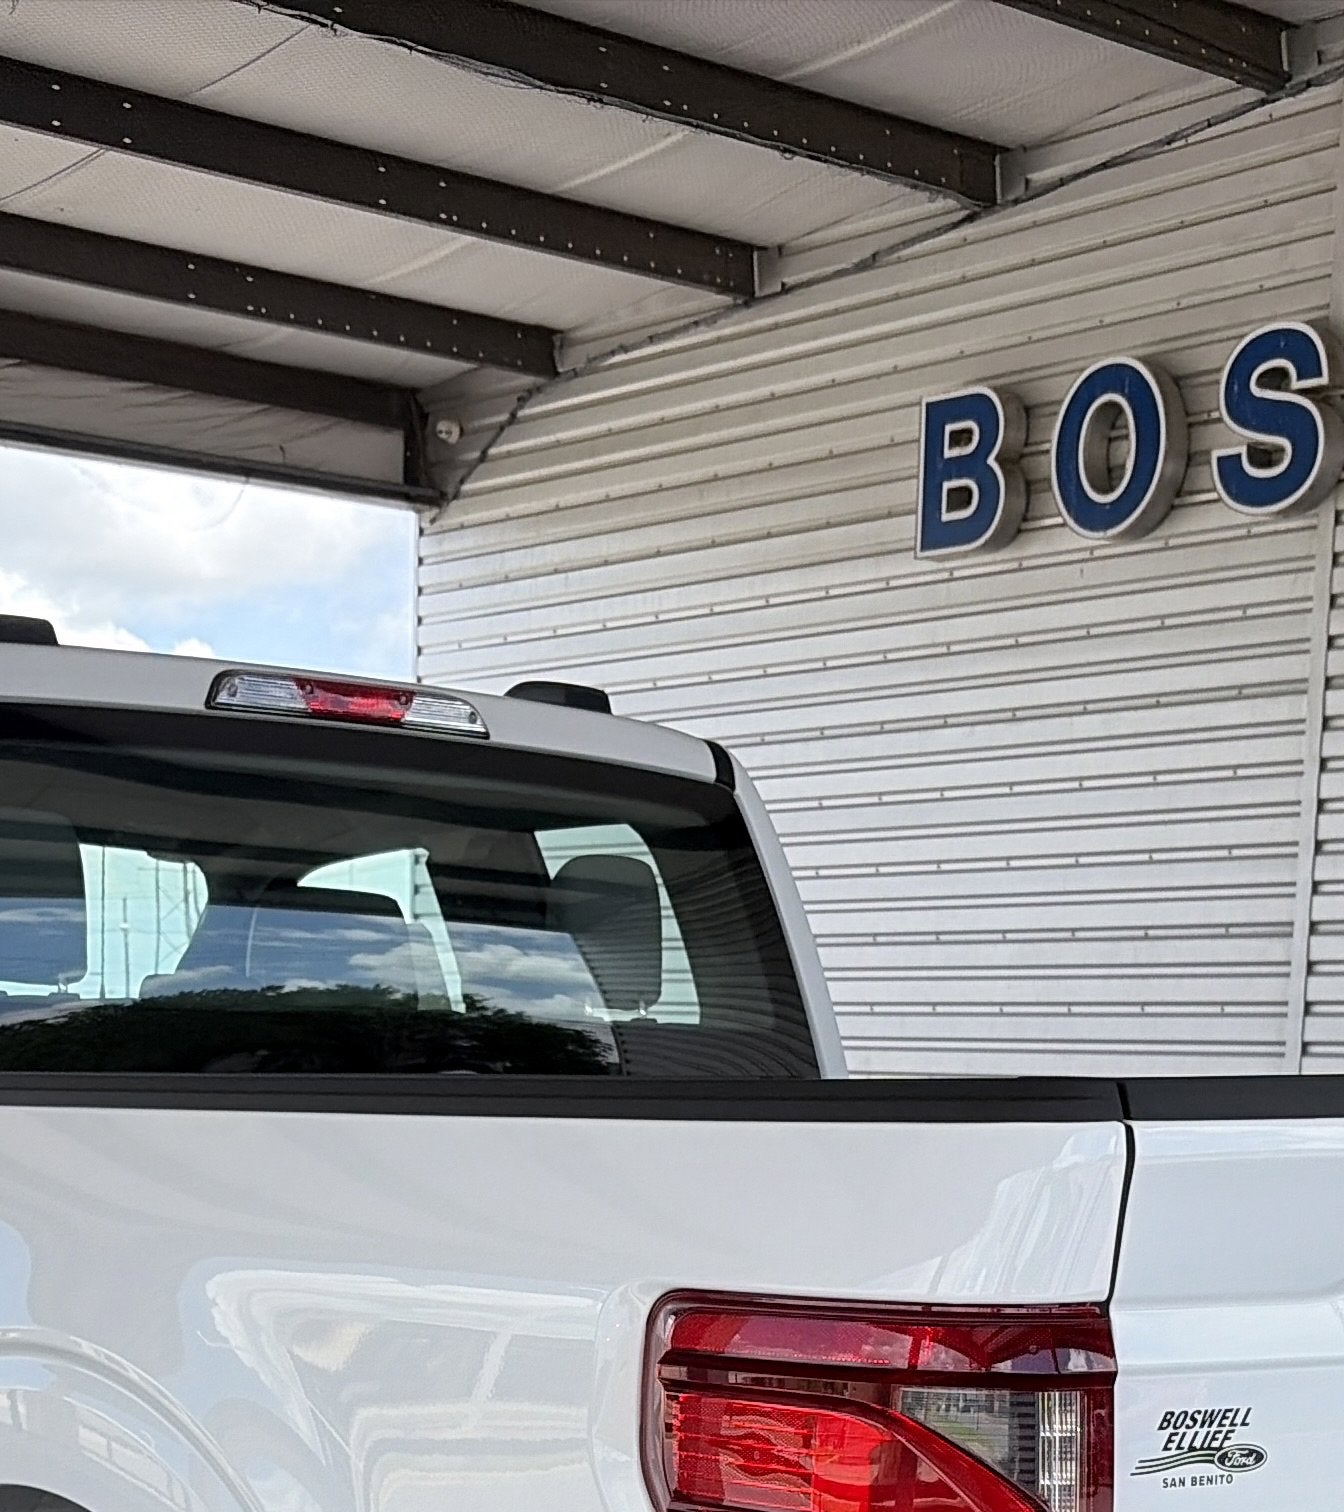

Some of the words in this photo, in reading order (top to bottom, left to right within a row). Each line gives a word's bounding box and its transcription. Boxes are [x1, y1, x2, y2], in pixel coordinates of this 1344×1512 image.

[1157, 1407, 1252, 1431] BOSWELL
[1161, 1429, 1236, 1451] ELLIFF
[1224, 1450, 1256, 1467] Ford
[1162, 1476, 1186, 1489] SAN
[1190, 1474, 1234, 1487] BENITO
